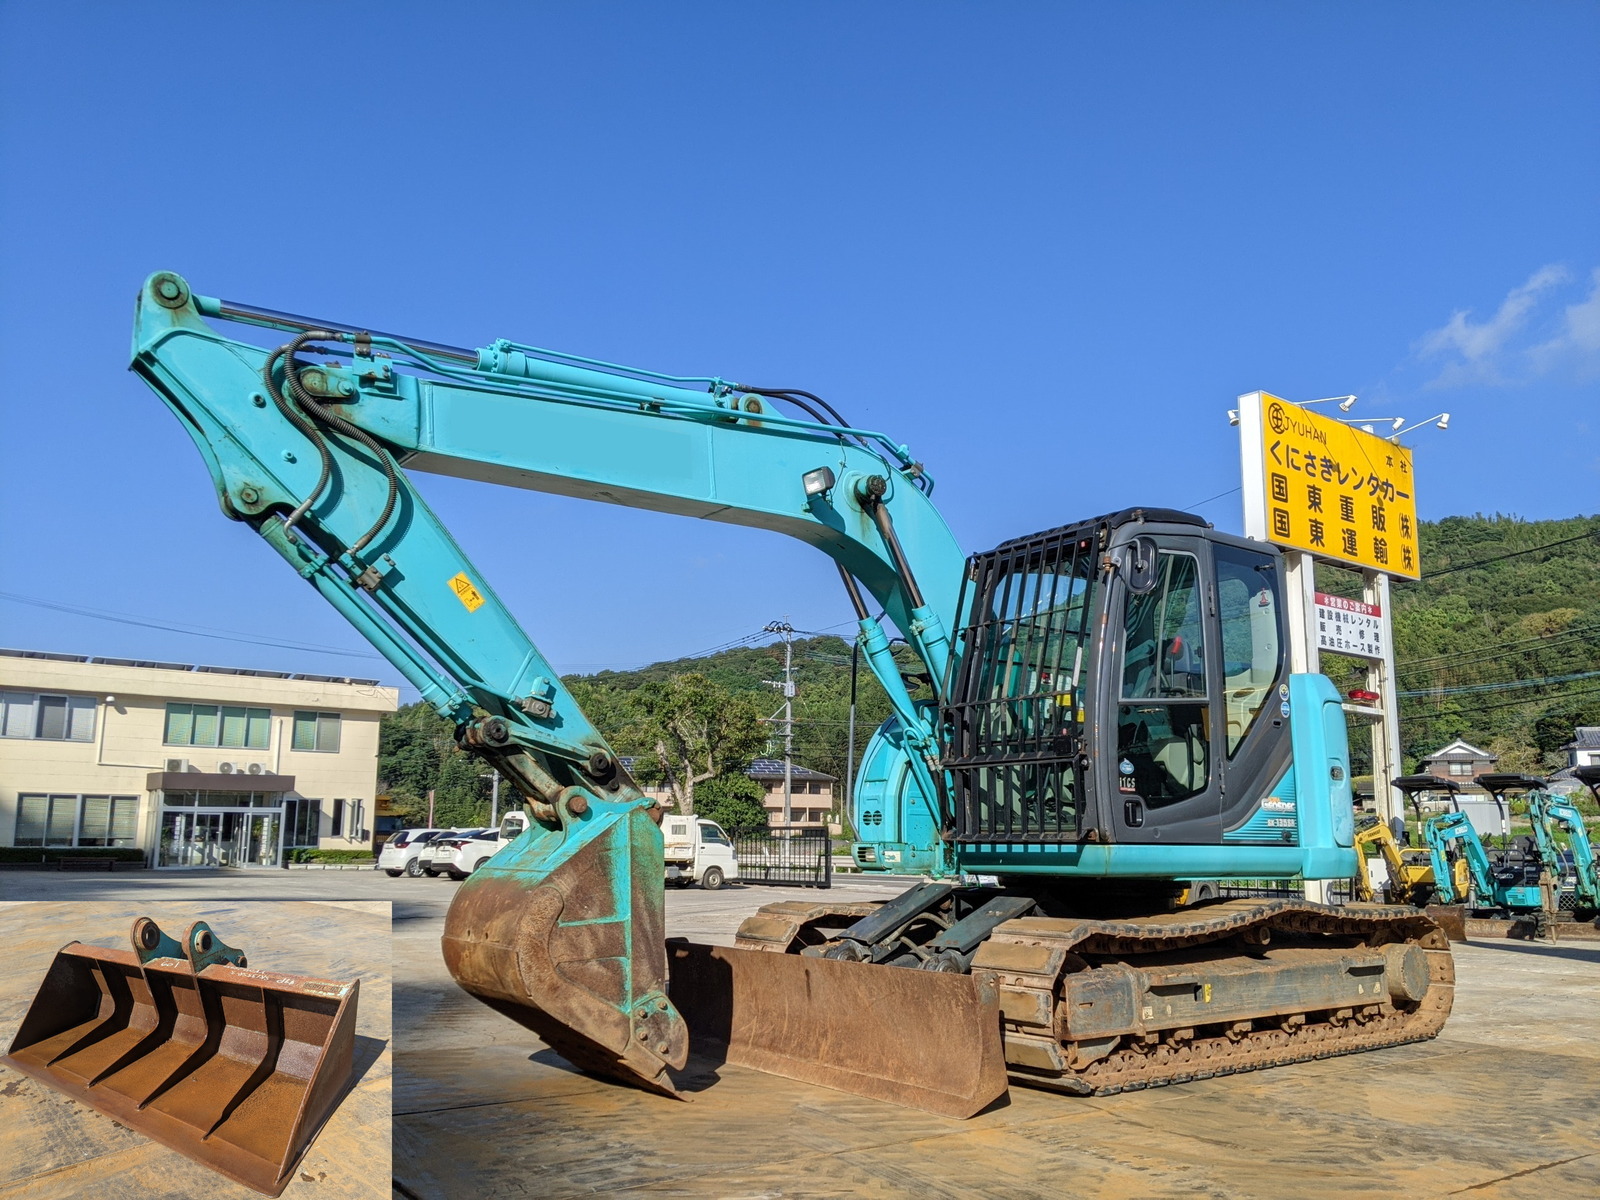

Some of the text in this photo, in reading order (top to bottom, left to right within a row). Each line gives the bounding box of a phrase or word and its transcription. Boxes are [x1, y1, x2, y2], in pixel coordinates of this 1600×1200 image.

[1284, 416, 1327, 446] JYUHAN
[1269, 440, 1410, 503] くにさきレンタカー
[1385, 455, 1408, 474] 本社
